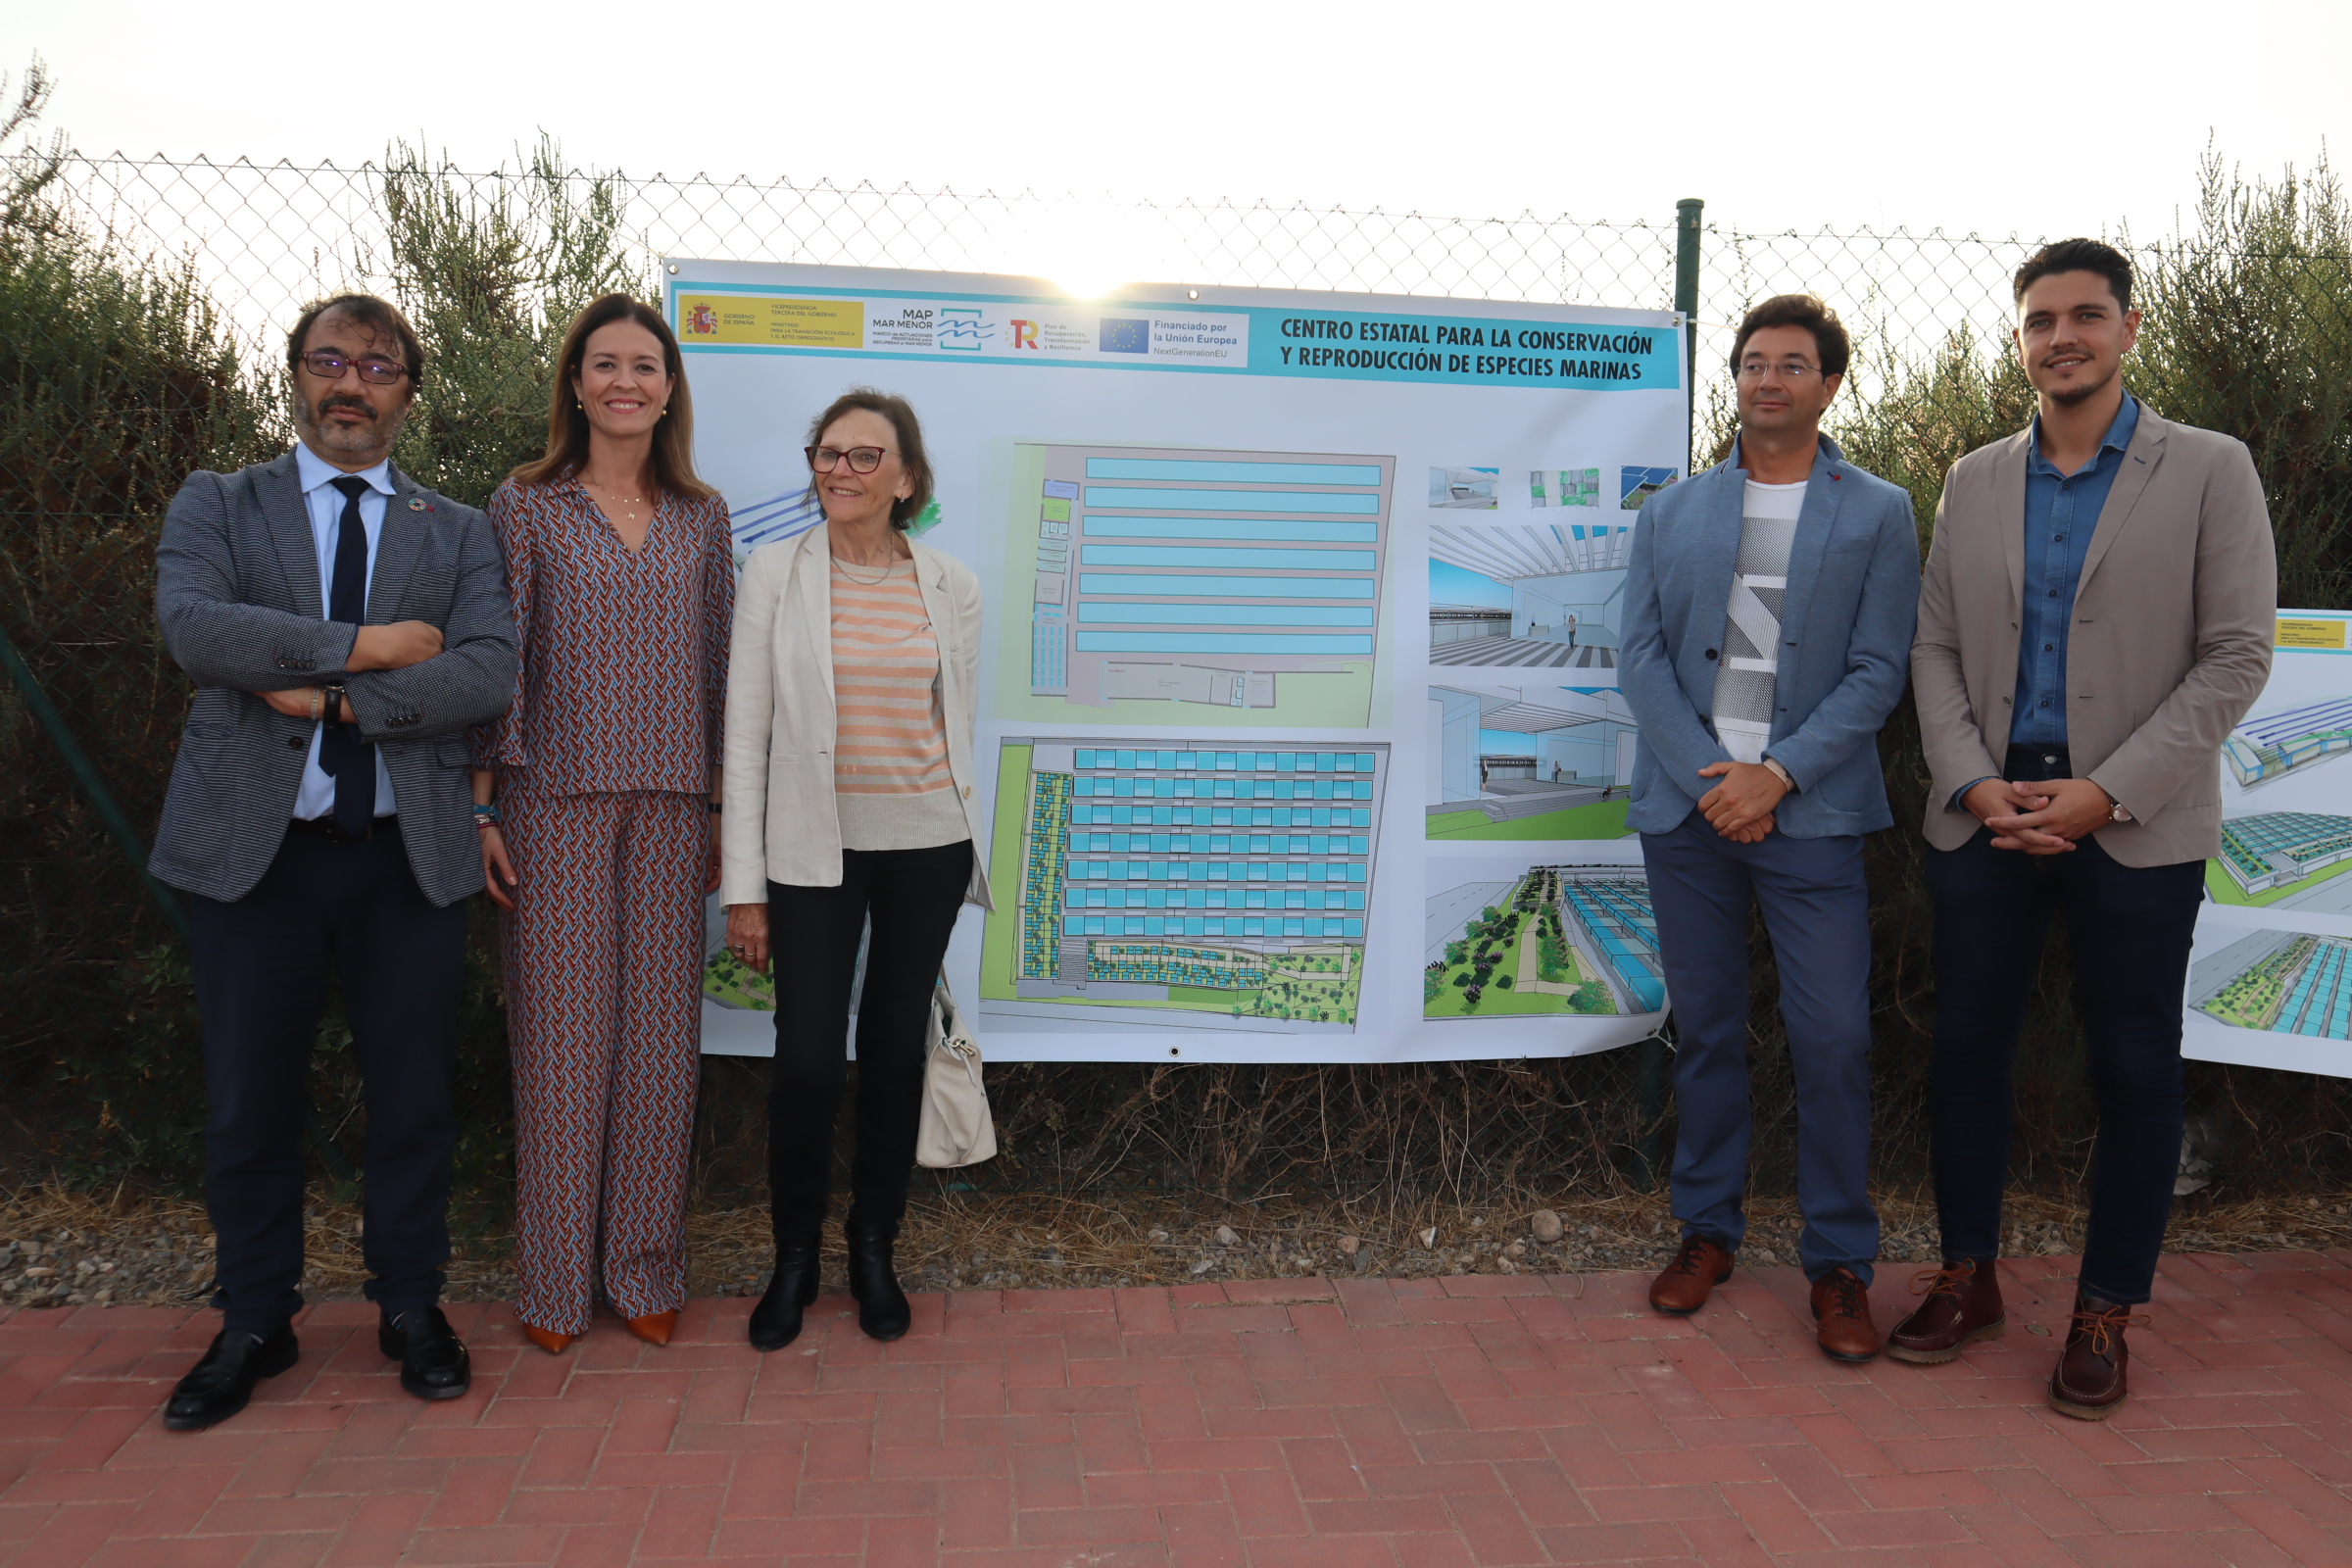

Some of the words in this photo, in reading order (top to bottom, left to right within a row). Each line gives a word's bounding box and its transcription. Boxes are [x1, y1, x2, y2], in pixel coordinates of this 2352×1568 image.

[903, 310, 933, 320] MAP
[872, 319, 895, 328] MAR
[897, 320, 933, 329] MENOR
[1154, 319, 1208, 331] Financiado
[1210, 323, 1227, 333] por
[1154, 333, 1163, 342] la
[1165, 333, 1194, 343] Unión
[1198, 335, 1238, 347] Europea
[1281, 318, 1353, 340] CENTRO
[1360, 321, 1430, 344] ESTATAL
[1437, 325, 1485, 347] PARA
[1491, 328, 1511, 348] LA
[1518, 329, 1652, 355] CONSERVACIÓN
[1154, 347, 1227, 358] NextGenerationEU
[1280, 346, 1293, 365] Y
[1298, 347, 1442, 372] REPRODUCCIÓN
[1448, 354, 1469, 373] DE
[1476, 355, 1553, 377] ESPECIES
[1559, 360, 1642, 380] MARINAS
